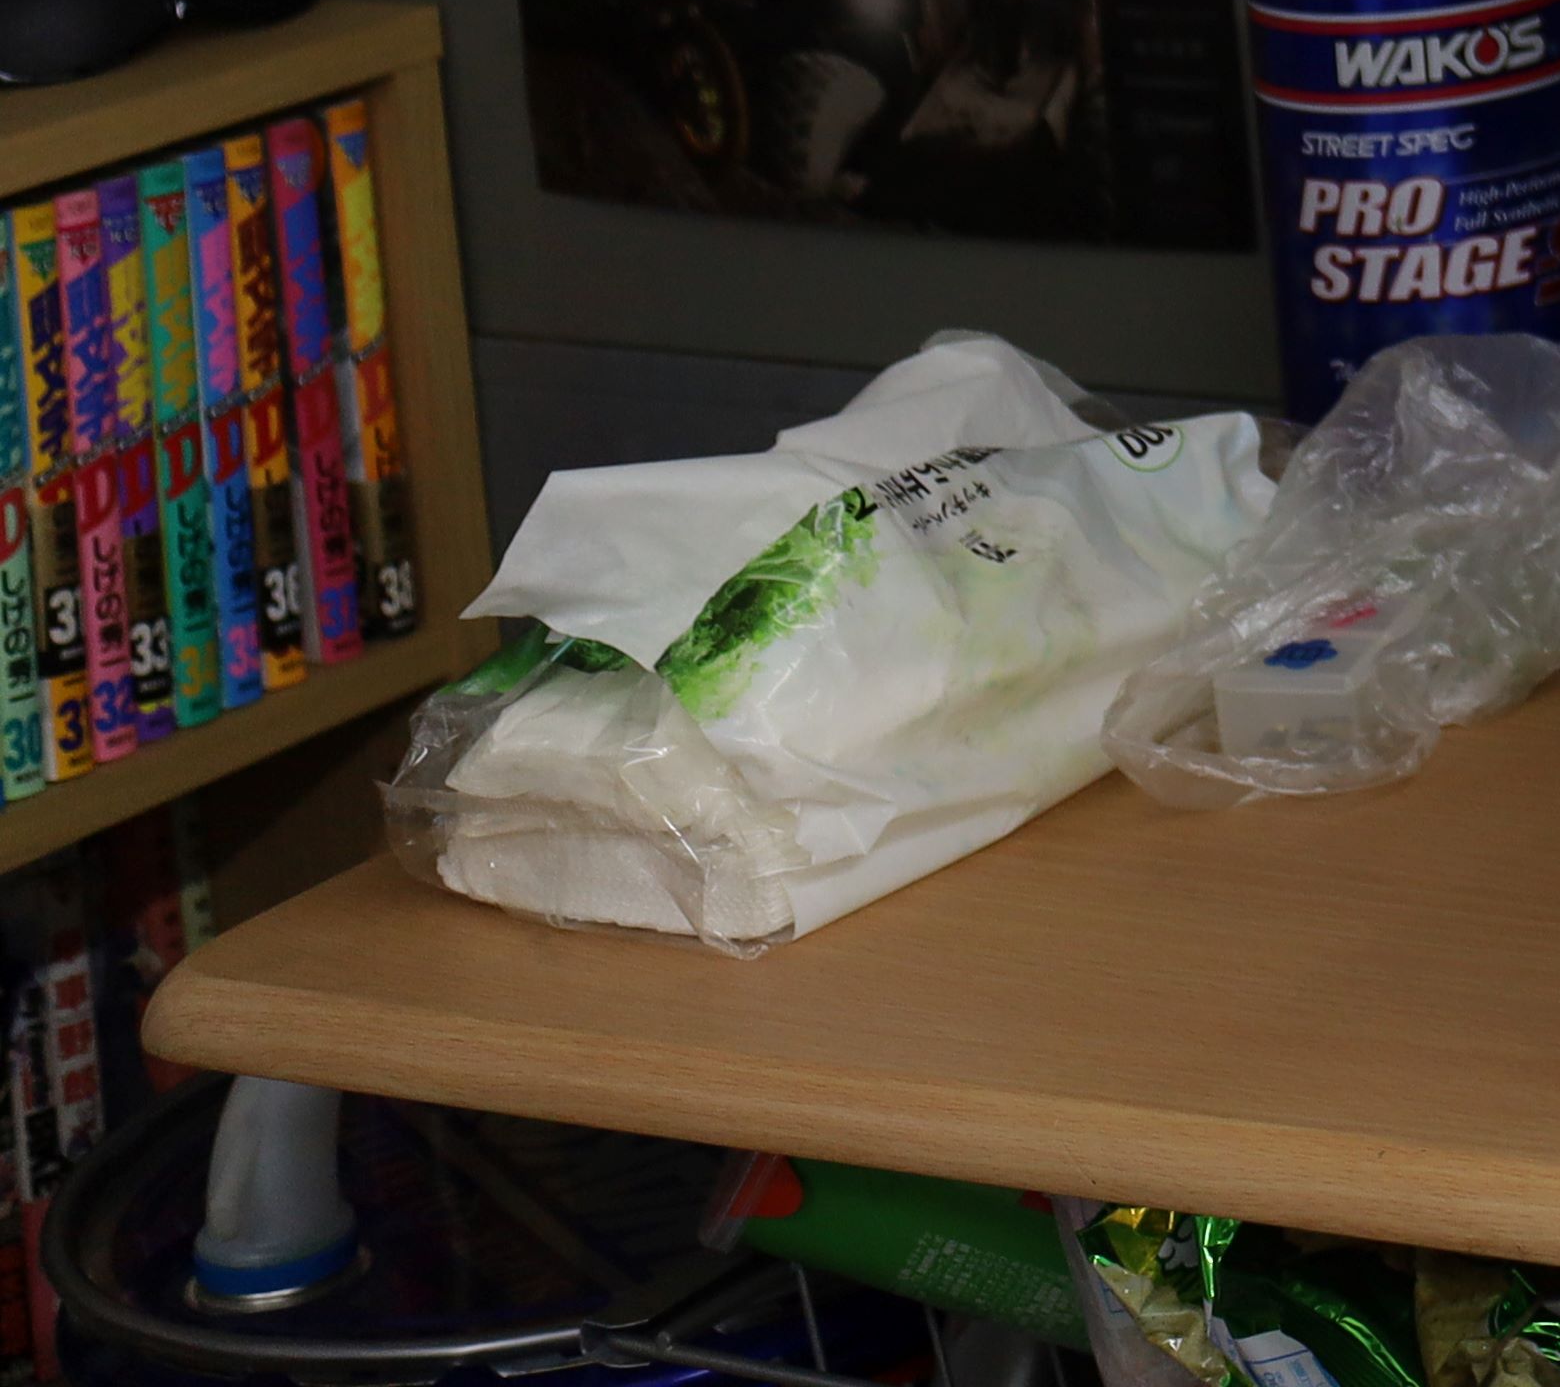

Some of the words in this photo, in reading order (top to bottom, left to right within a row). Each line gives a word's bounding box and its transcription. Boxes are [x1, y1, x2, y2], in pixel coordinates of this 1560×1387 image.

[1334, 16, 1546, 89] WAKO'S
[1301, 131, 1395, 159] STREET
[1397, 123, 1476, 157] SPEC
[1300, 175, 1444, 237] PRO
[1310, 227, 1537, 302] STAGE
